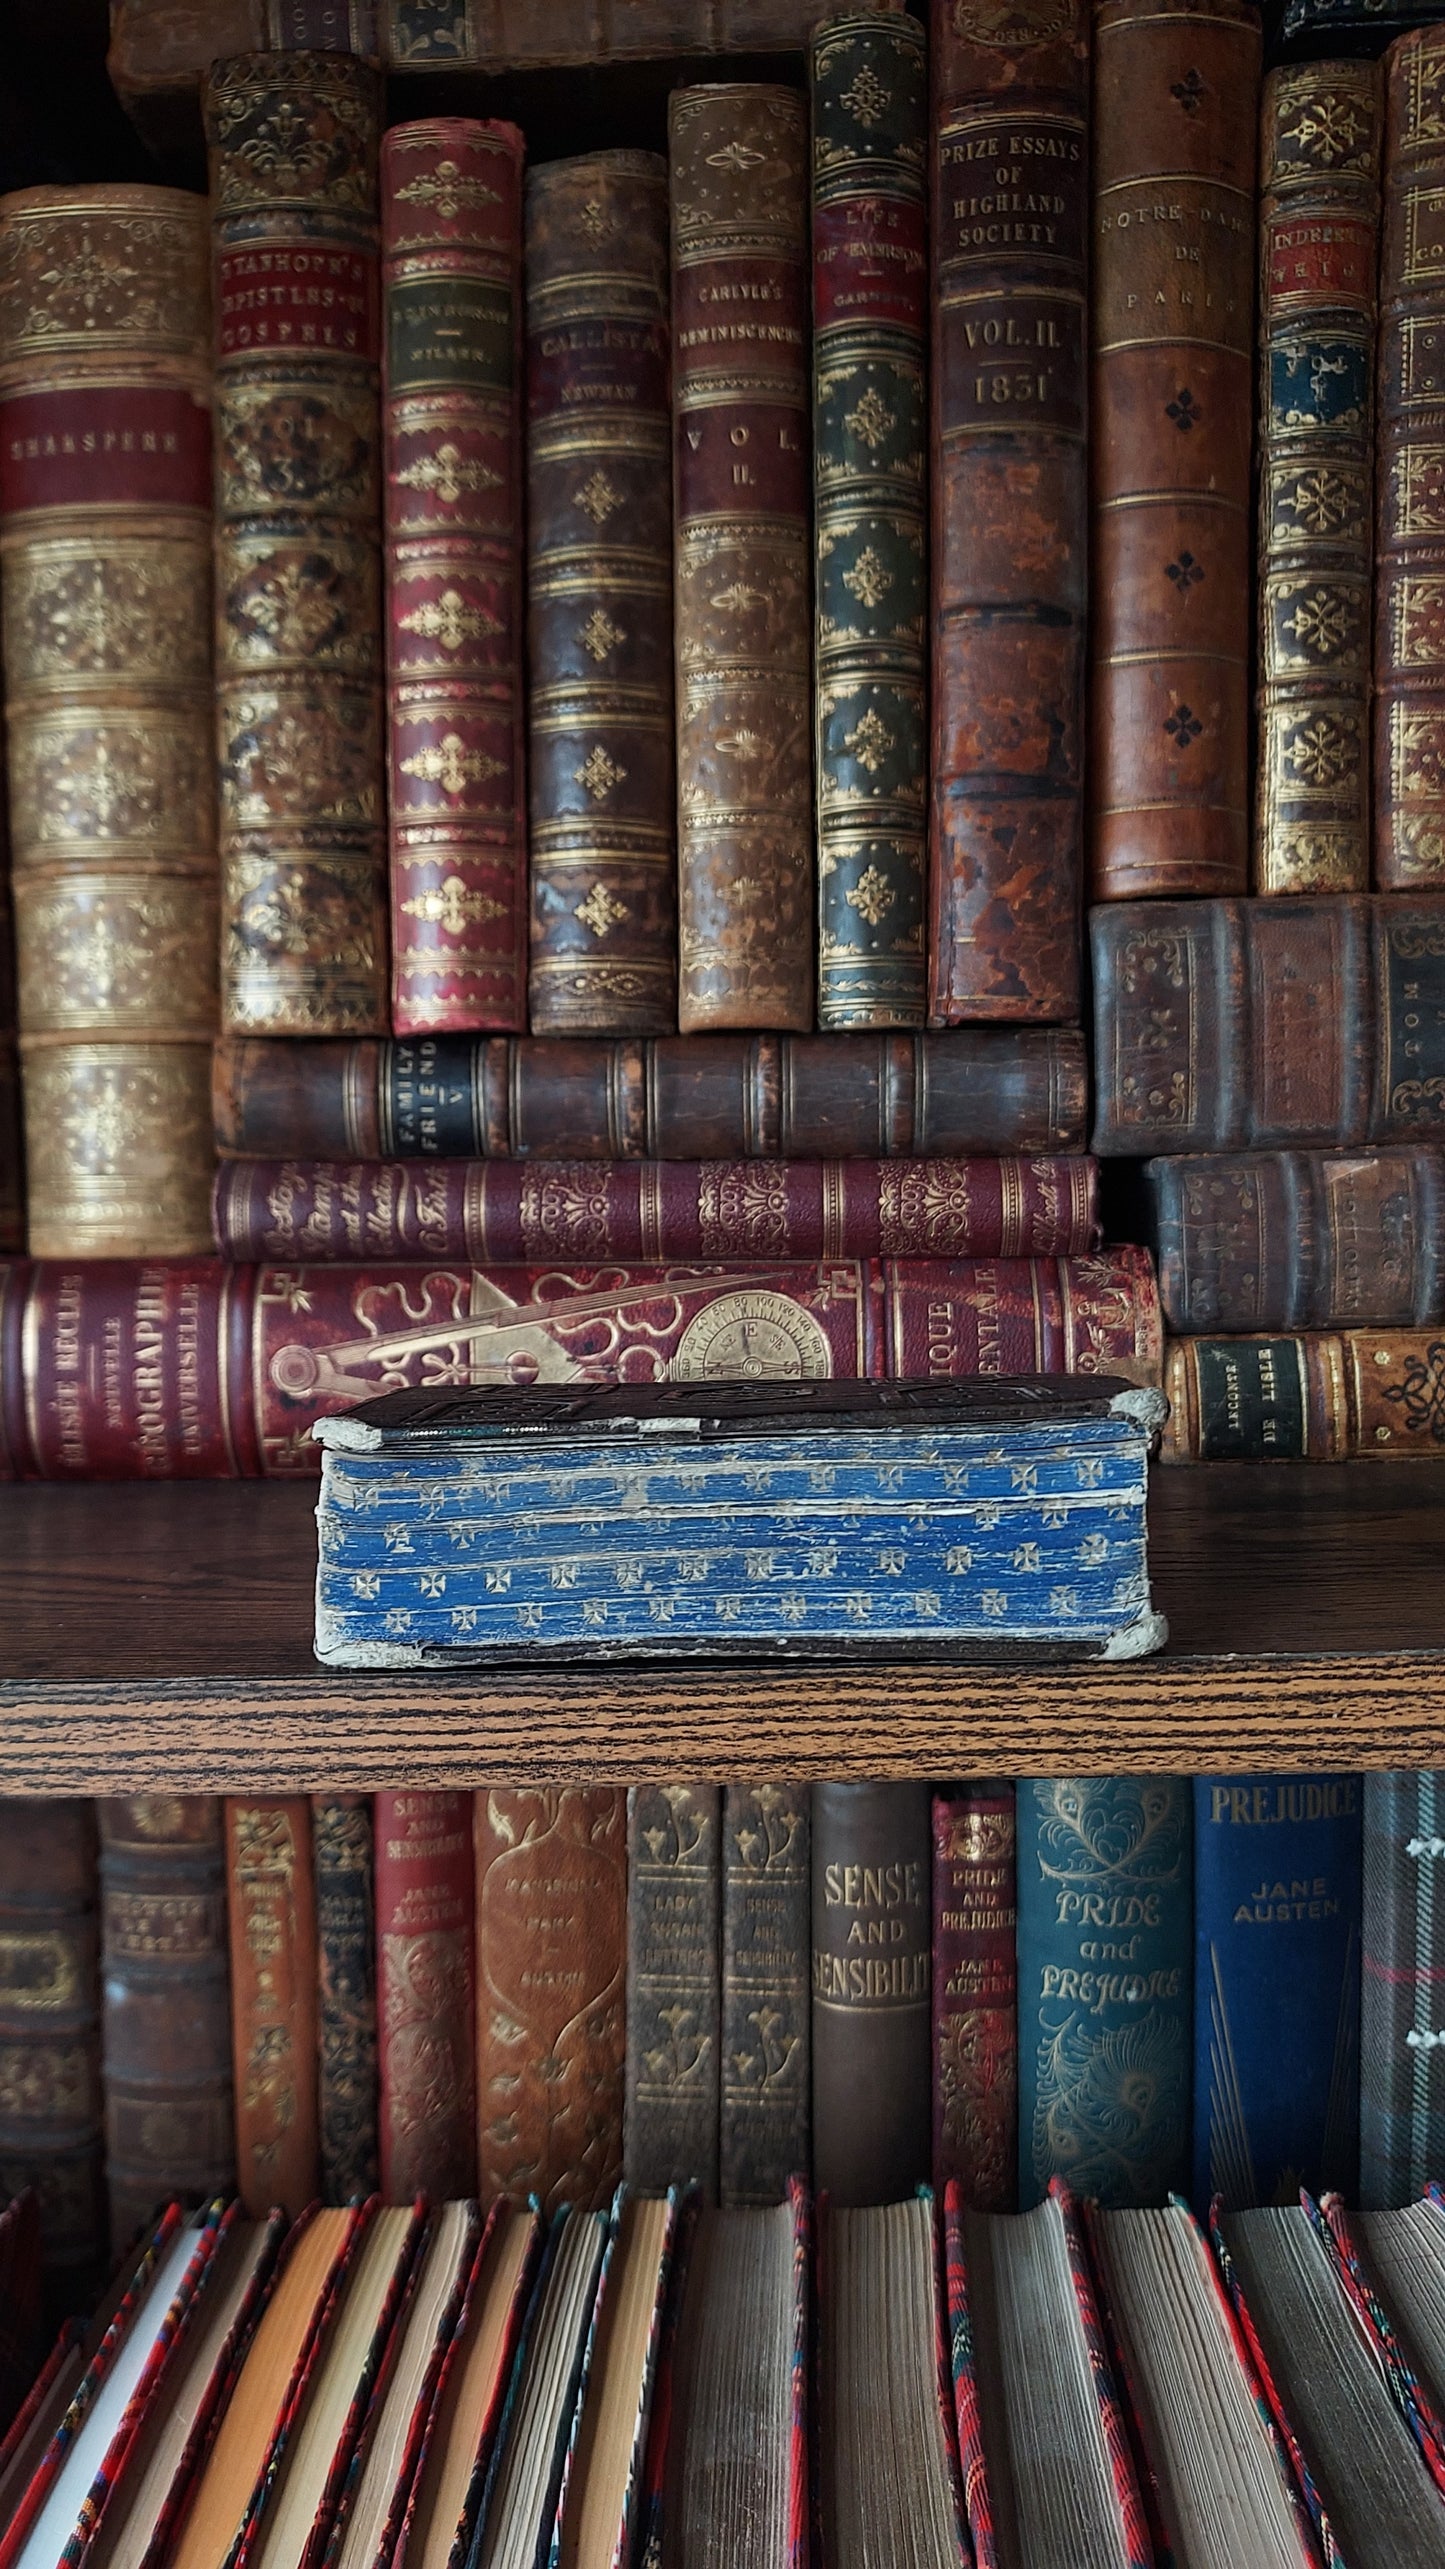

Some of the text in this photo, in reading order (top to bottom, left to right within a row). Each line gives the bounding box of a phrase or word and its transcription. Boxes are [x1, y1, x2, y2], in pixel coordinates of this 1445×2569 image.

[940, 136, 1080, 166] PRIZE ESSAYS
[996, 167, 1022, 185] OF
[954, 194, 1065, 219] HIGHLAND
[959, 224, 1057, 247] SOCIETY
[1176, 247, 1200, 262] DE
[1127, 290, 1236, 312] PARIS
[560, 384, 638, 404] NEWMAN
[976, 373, 1046, 403] 1831
[395, 1046, 414, 1142] FAMILY
[418, 1041, 438, 1150] FRIEND
[1225, 1364, 1239, 1429] LECONTE
[1258, 1348, 1276, 1443] DE LISLE
[1210, 1782, 1358, 1826] PREJUDICE
[824, 1861, 921, 1910] SENSE
[952, 1869, 1008, 1888] PRIDE
[1251, 1877, 1328, 1900] JANE
[963, 1892, 999, 1908] AND
[1055, 1888, 1161, 1928] PRIDE
[1233, 1900, 1340, 1924] AUSTEN
[847, 1919, 905, 1946] AND
[942, 1909, 1015, 1931] PREJUDICE
[1080, 1935, 1143, 1961] and
[945, 1976, 1015, 1996] AUSTEN
